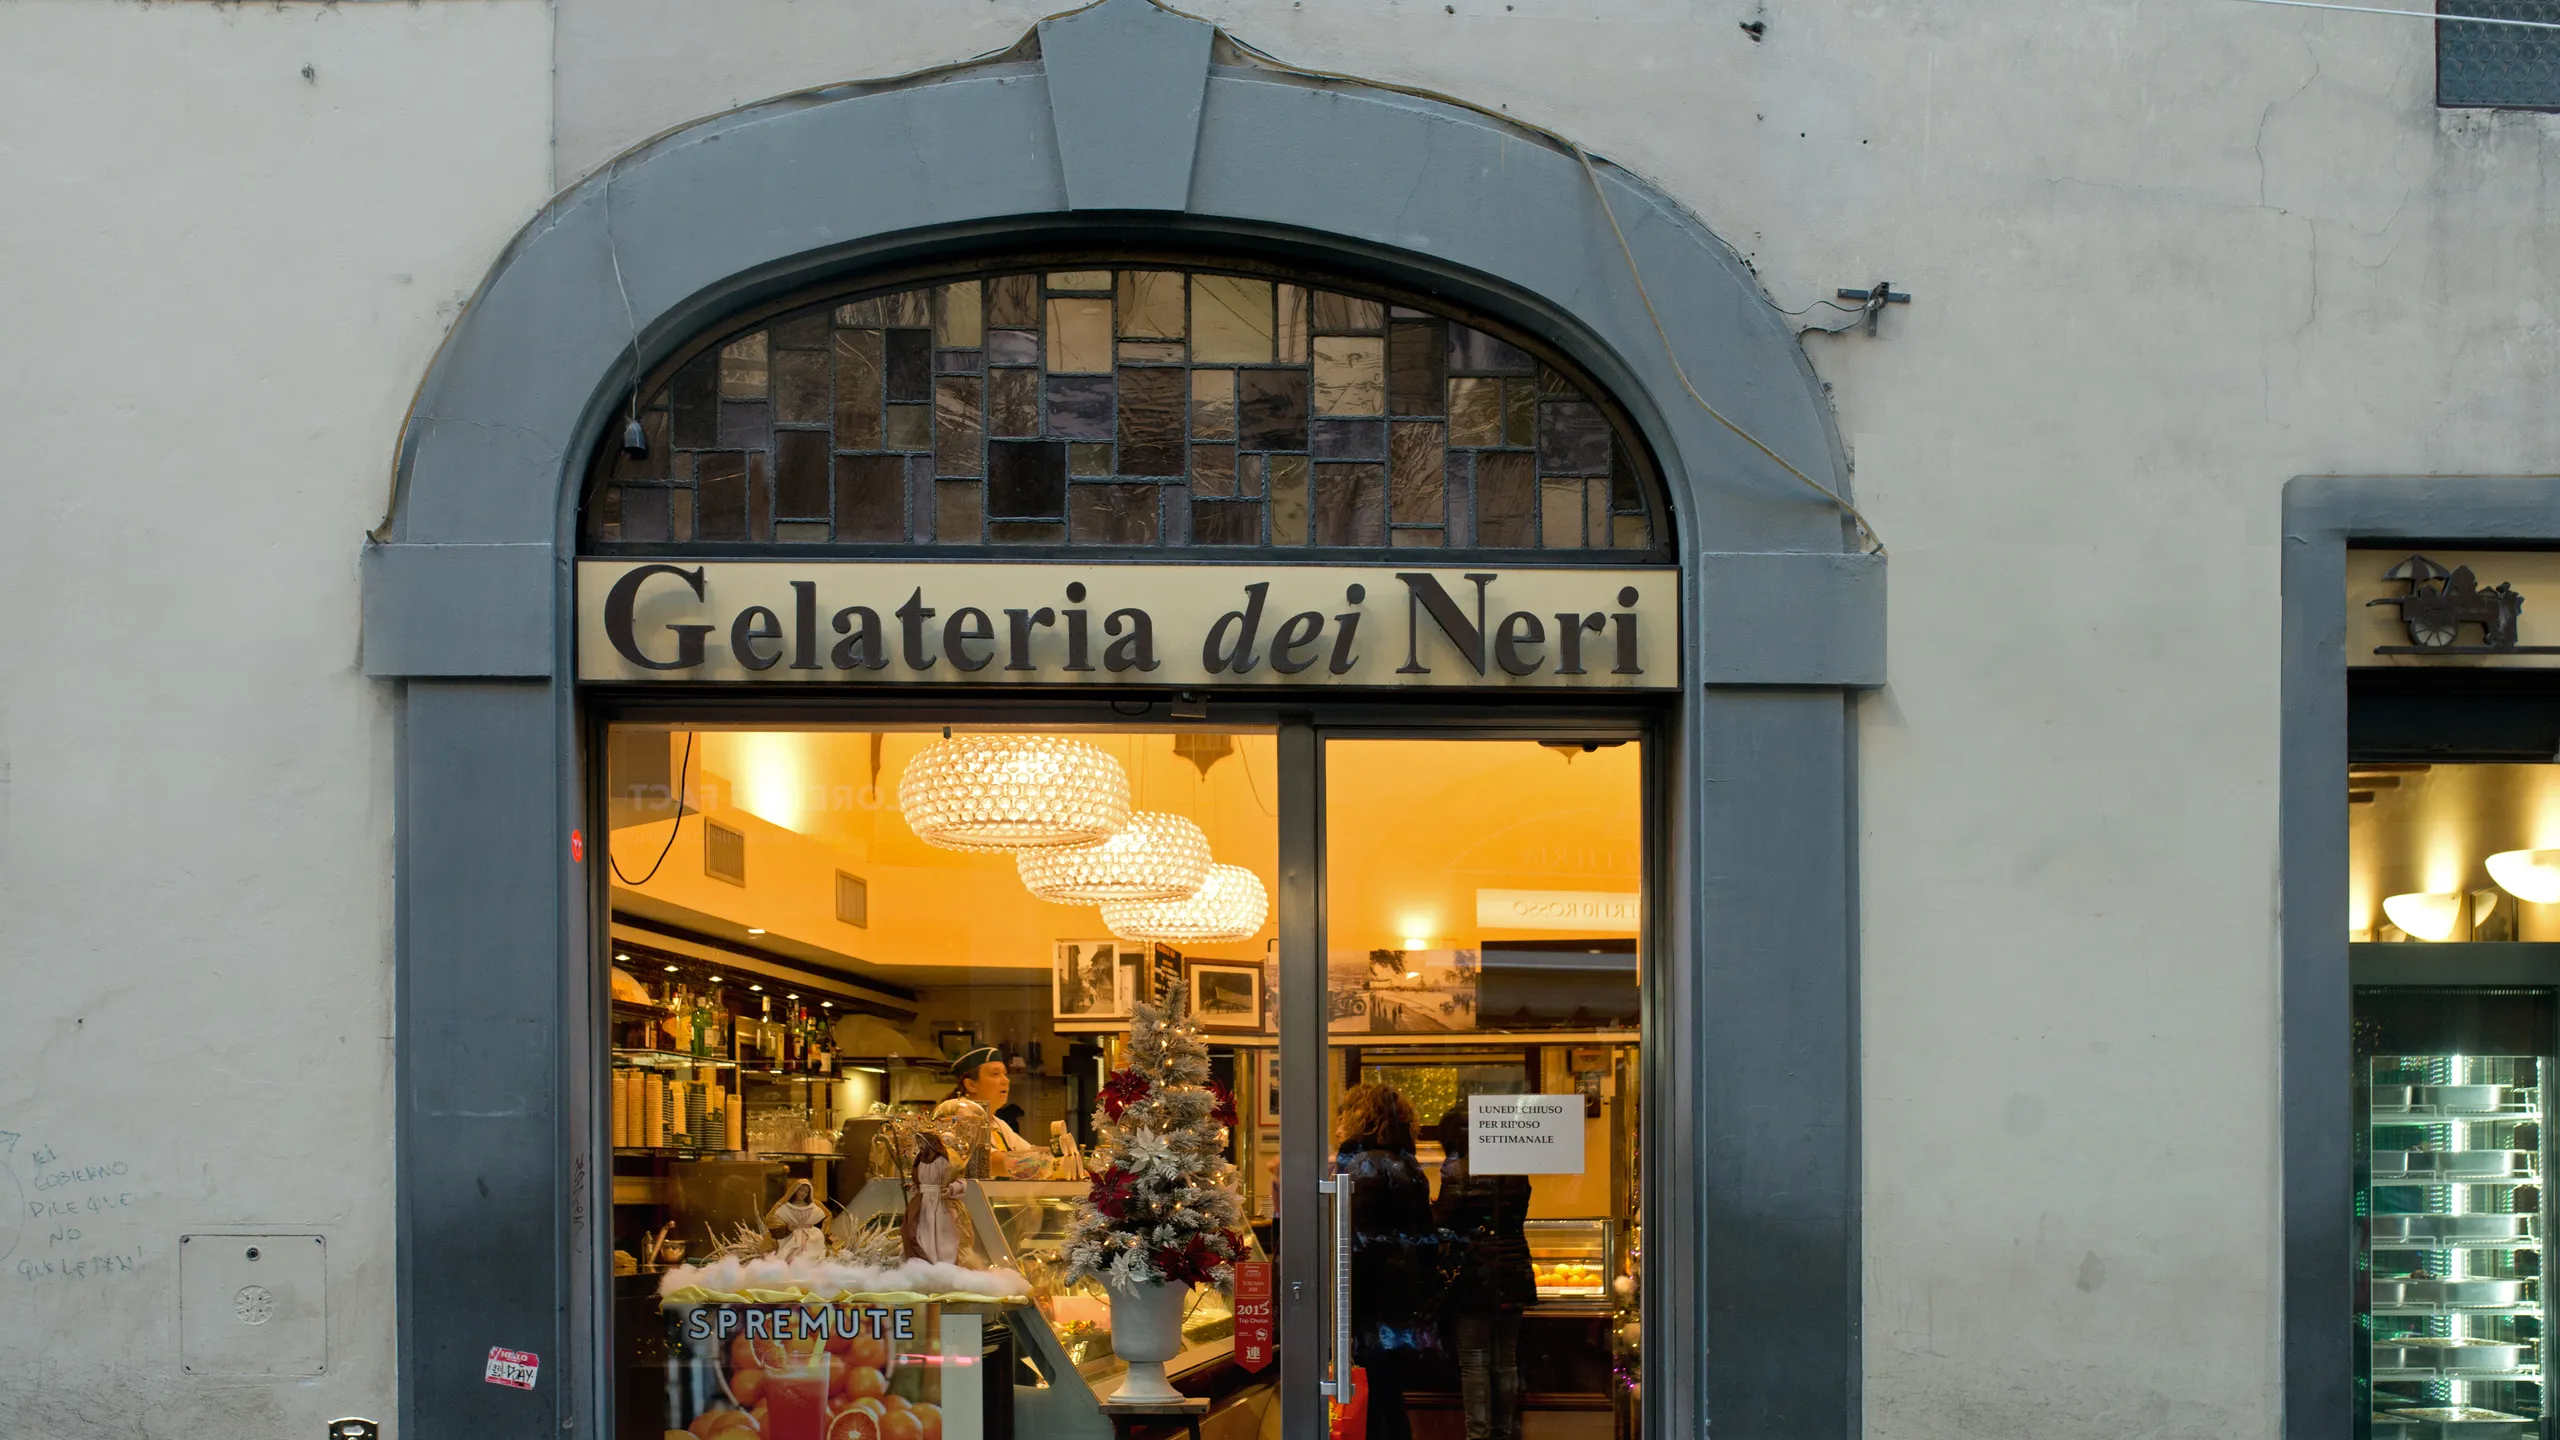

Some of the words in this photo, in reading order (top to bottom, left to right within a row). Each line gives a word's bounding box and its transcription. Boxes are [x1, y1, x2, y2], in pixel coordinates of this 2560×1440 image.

[604, 564, 1161, 672] Gelateria
[1203, 581, 1366, 675] dei
[1395, 572, 1644, 677] Neri
[1522, 1105, 1562, 1114] CHIUSO
[1479, 1120, 1498, 1128] PER
[1479, 1135, 1554, 1143] SETTIMANALE
[49, 1223, 82, 1248] NO
[1237, 1301, 1269, 1315] 2015
[688, 1306, 915, 1341] SPREMUTE
[1239, 1317, 1249, 1325] Top
